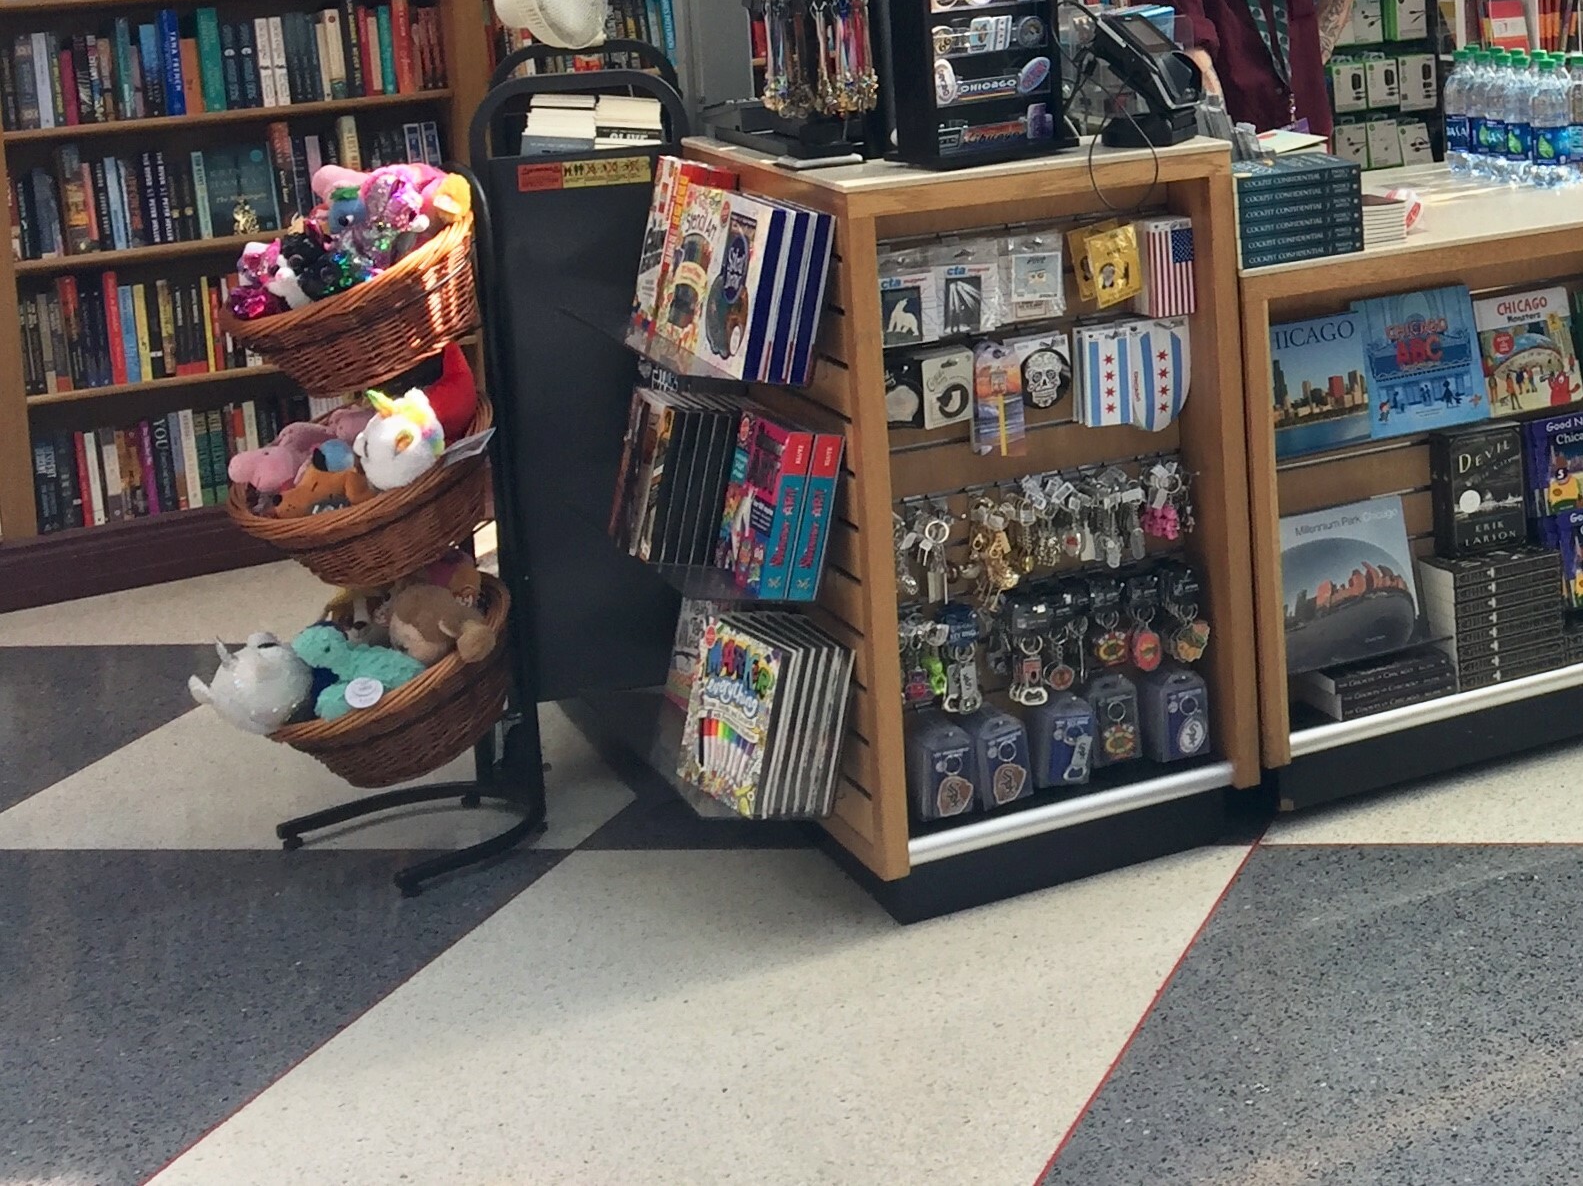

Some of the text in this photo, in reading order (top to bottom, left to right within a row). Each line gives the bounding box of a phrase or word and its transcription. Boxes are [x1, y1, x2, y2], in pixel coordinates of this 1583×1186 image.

[171, 51, 182, 91] FRENCH
[959, 78, 1017, 94] CHICAGO
[1244, 173, 1320, 188] COCKPIT CONFIDENTIAL
[1245, 188, 1322, 203] COCKPIT CONFIDENTIAL
[1246, 203, 1322, 218] COCKPIT CONFIDENTIAL
[1246, 218, 1322, 234] COCKPIT CONFIDENTIAL
[1248, 233, 1323, 249] COCKPIT CONFIDENTIAL
[1249, 247, 1324, 264] COCKPIT CONFIDENTIAL
[947, 265, 966, 276] cta
[881, 277, 902, 289] cta
[1497, 295, 1548, 316] CHICAGO
[1507, 312, 1541, 324] Monsters
[1385, 317, 1449, 341] CHICAGO
[1396, 335, 1443, 365] ABC
[1546, 419, 1572, 432] Good
[153, 418, 168, 450] YOU
[1458, 439, 1511, 474] DEVIL
[1295, 518, 1339, 537] Millennium
[1341, 514, 1361, 528] Park
[1475, 520, 1505, 532] ERIK
[1464, 530, 1517, 547] LARSON
